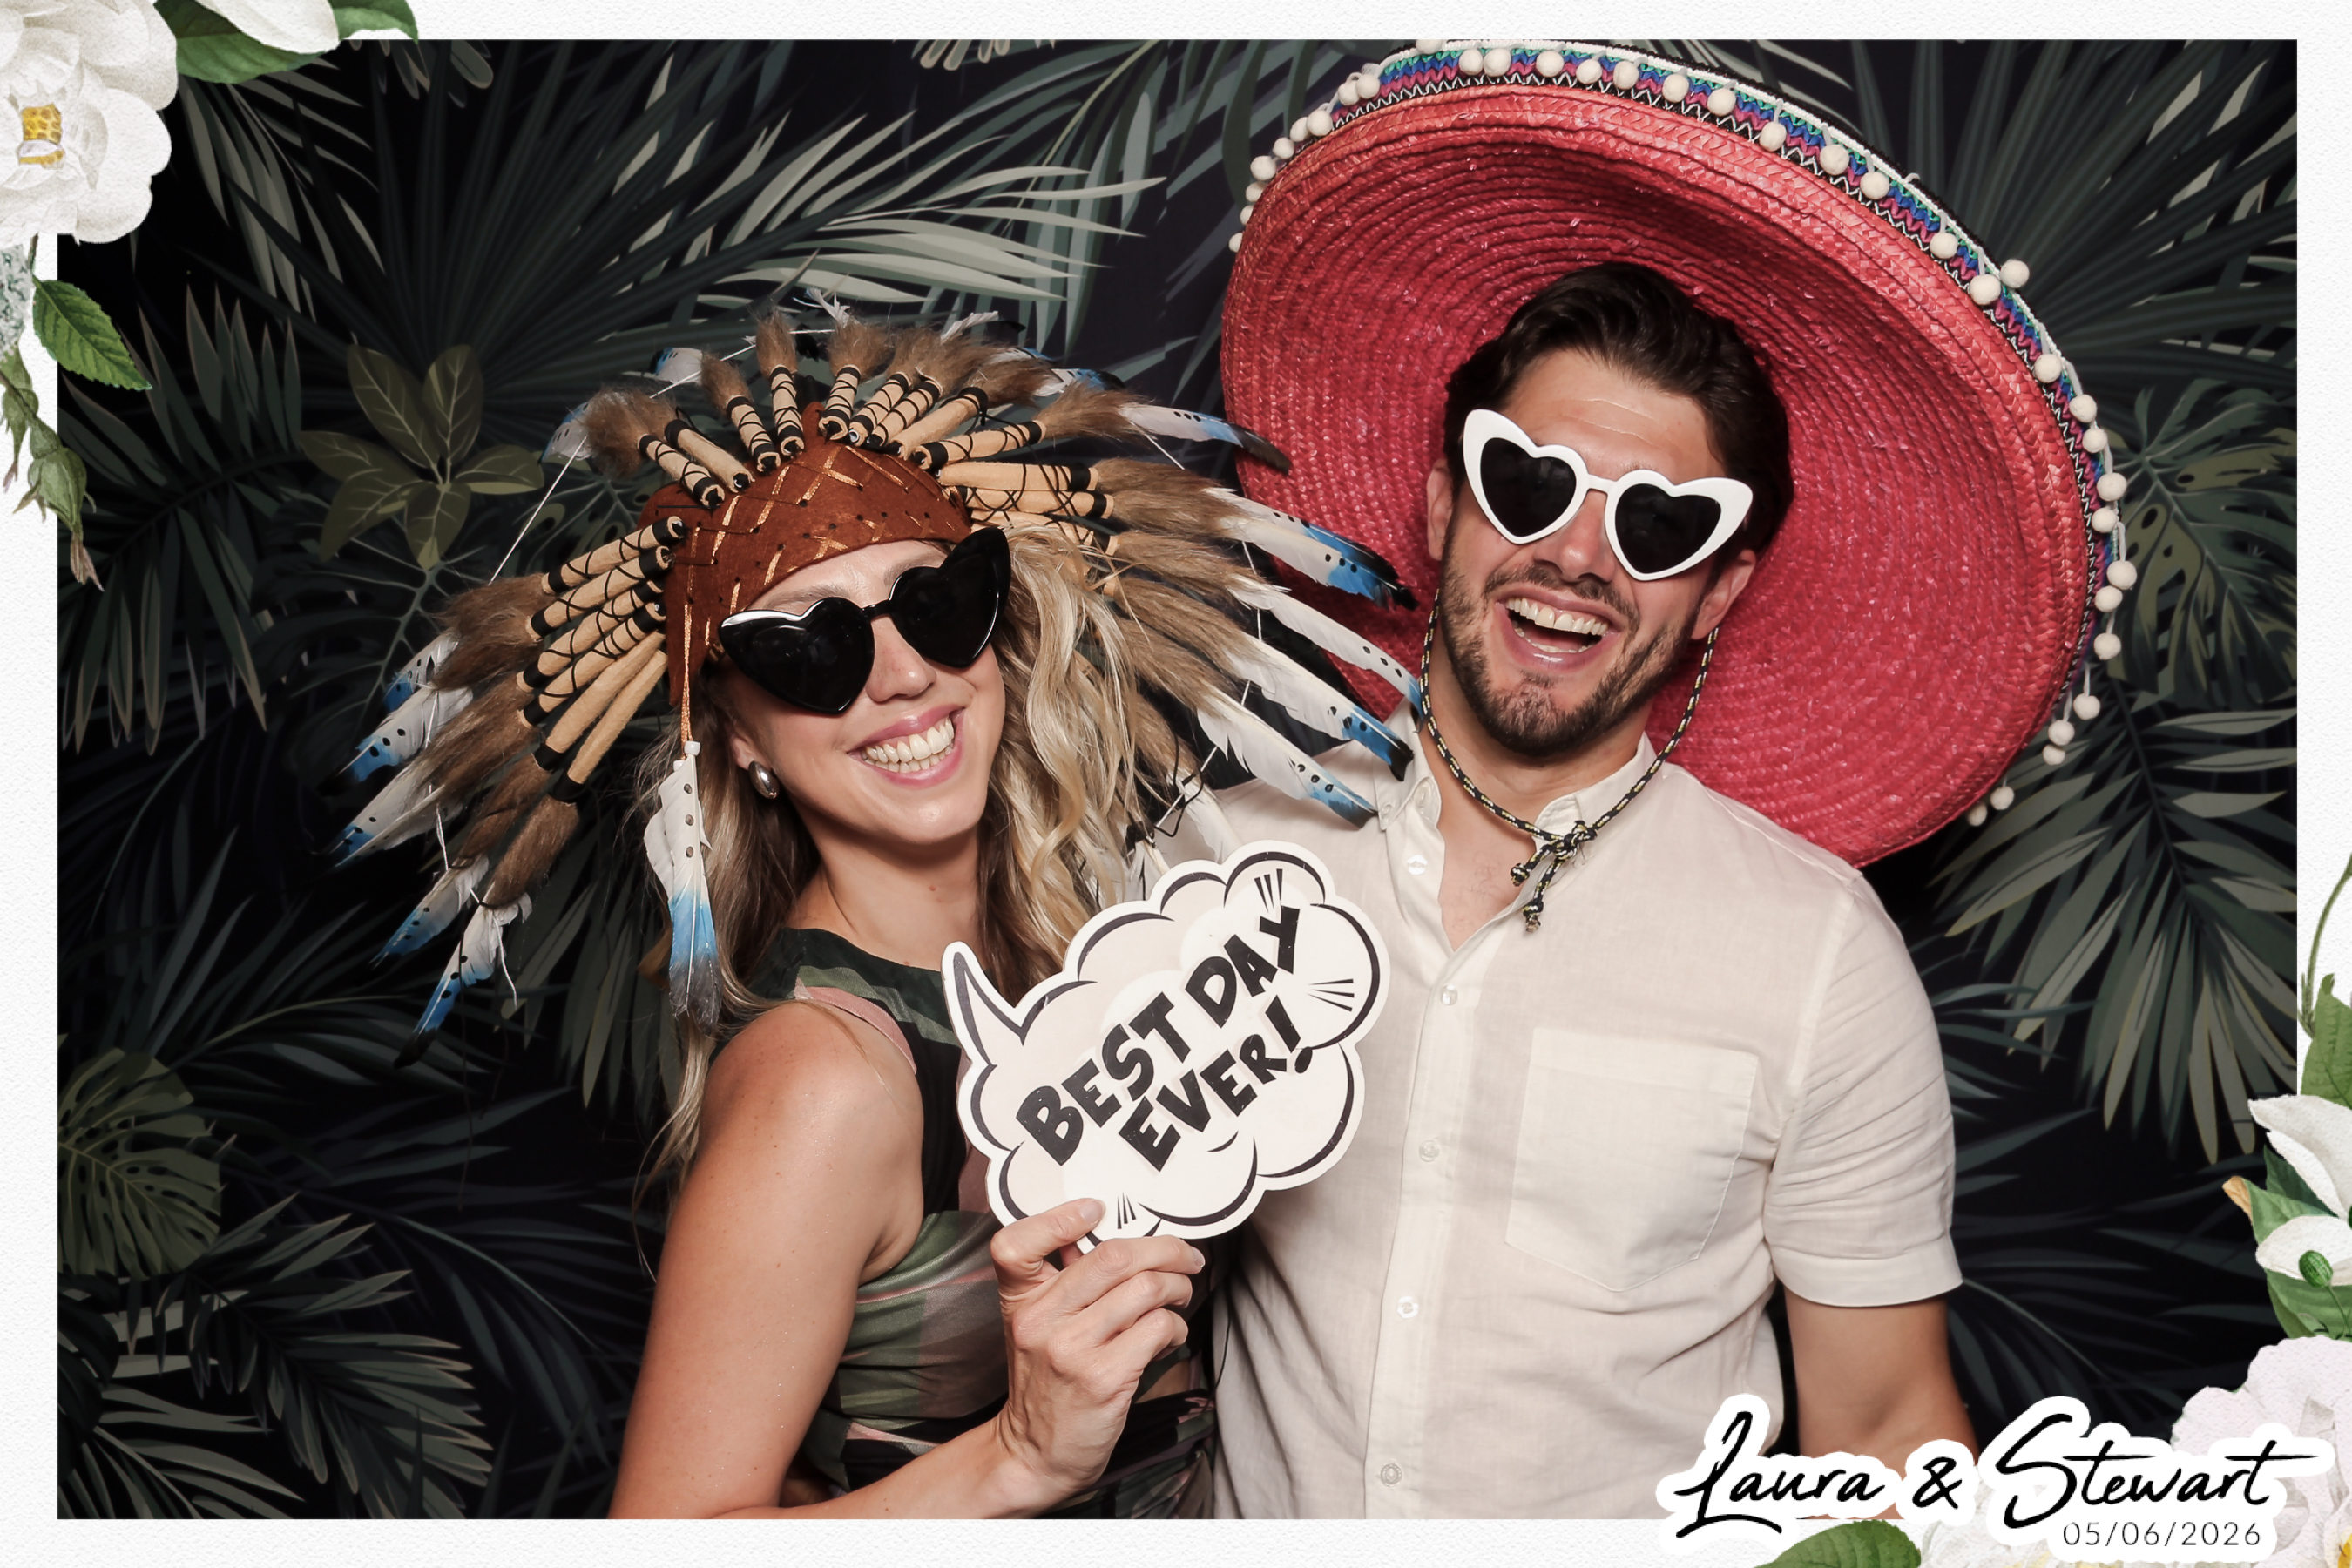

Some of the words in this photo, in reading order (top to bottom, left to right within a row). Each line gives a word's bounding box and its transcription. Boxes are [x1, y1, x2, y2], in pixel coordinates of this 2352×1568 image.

[1016, 992, 1191, 1166] BEST
[1185, 905, 1300, 1028] DAY
[1119, 994, 1313, 1172] EVER!
